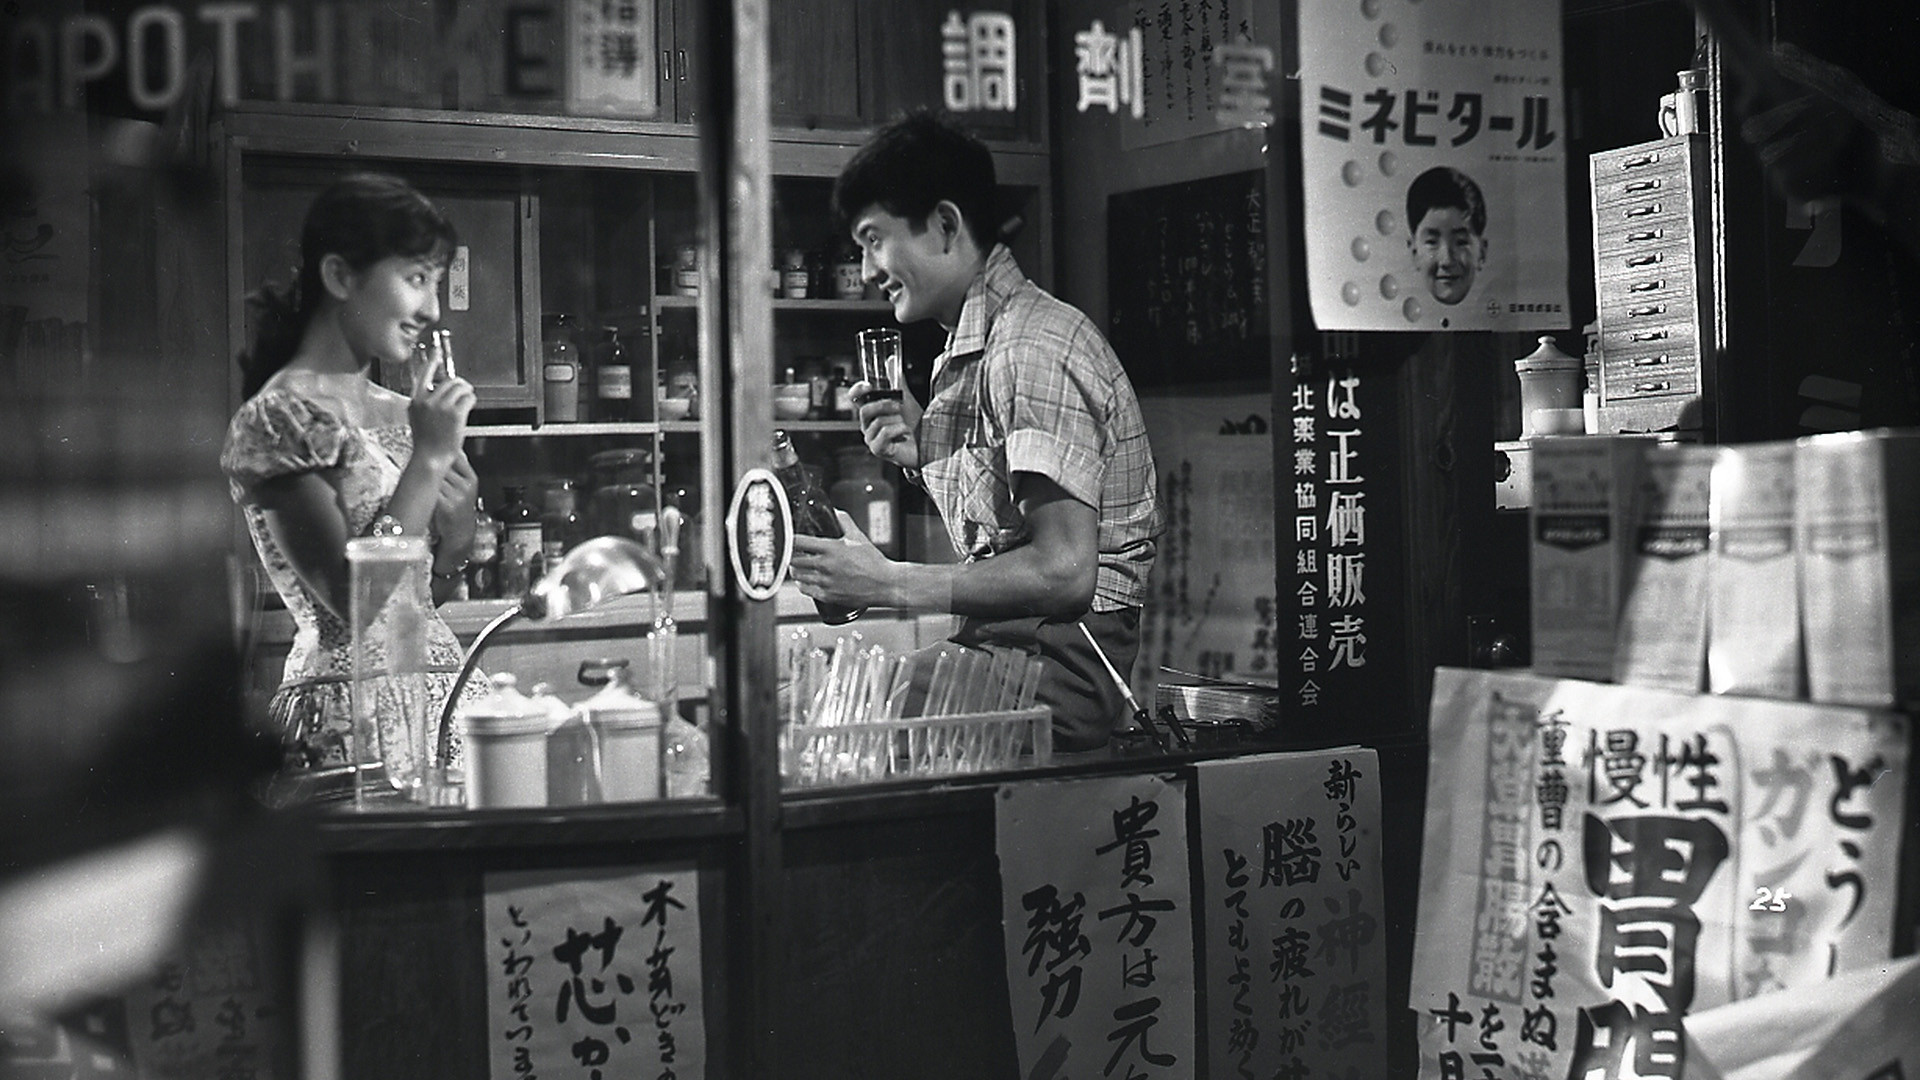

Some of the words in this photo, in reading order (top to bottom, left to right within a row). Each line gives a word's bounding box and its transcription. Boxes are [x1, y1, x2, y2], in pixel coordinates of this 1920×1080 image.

[1318, 84, 1557, 149] ミネビタール
[1583, 727, 1730, 814] 慢性
[553, 915, 636, 1080] 芯か
[1095, 795, 1178, 1080] 貴方は元
